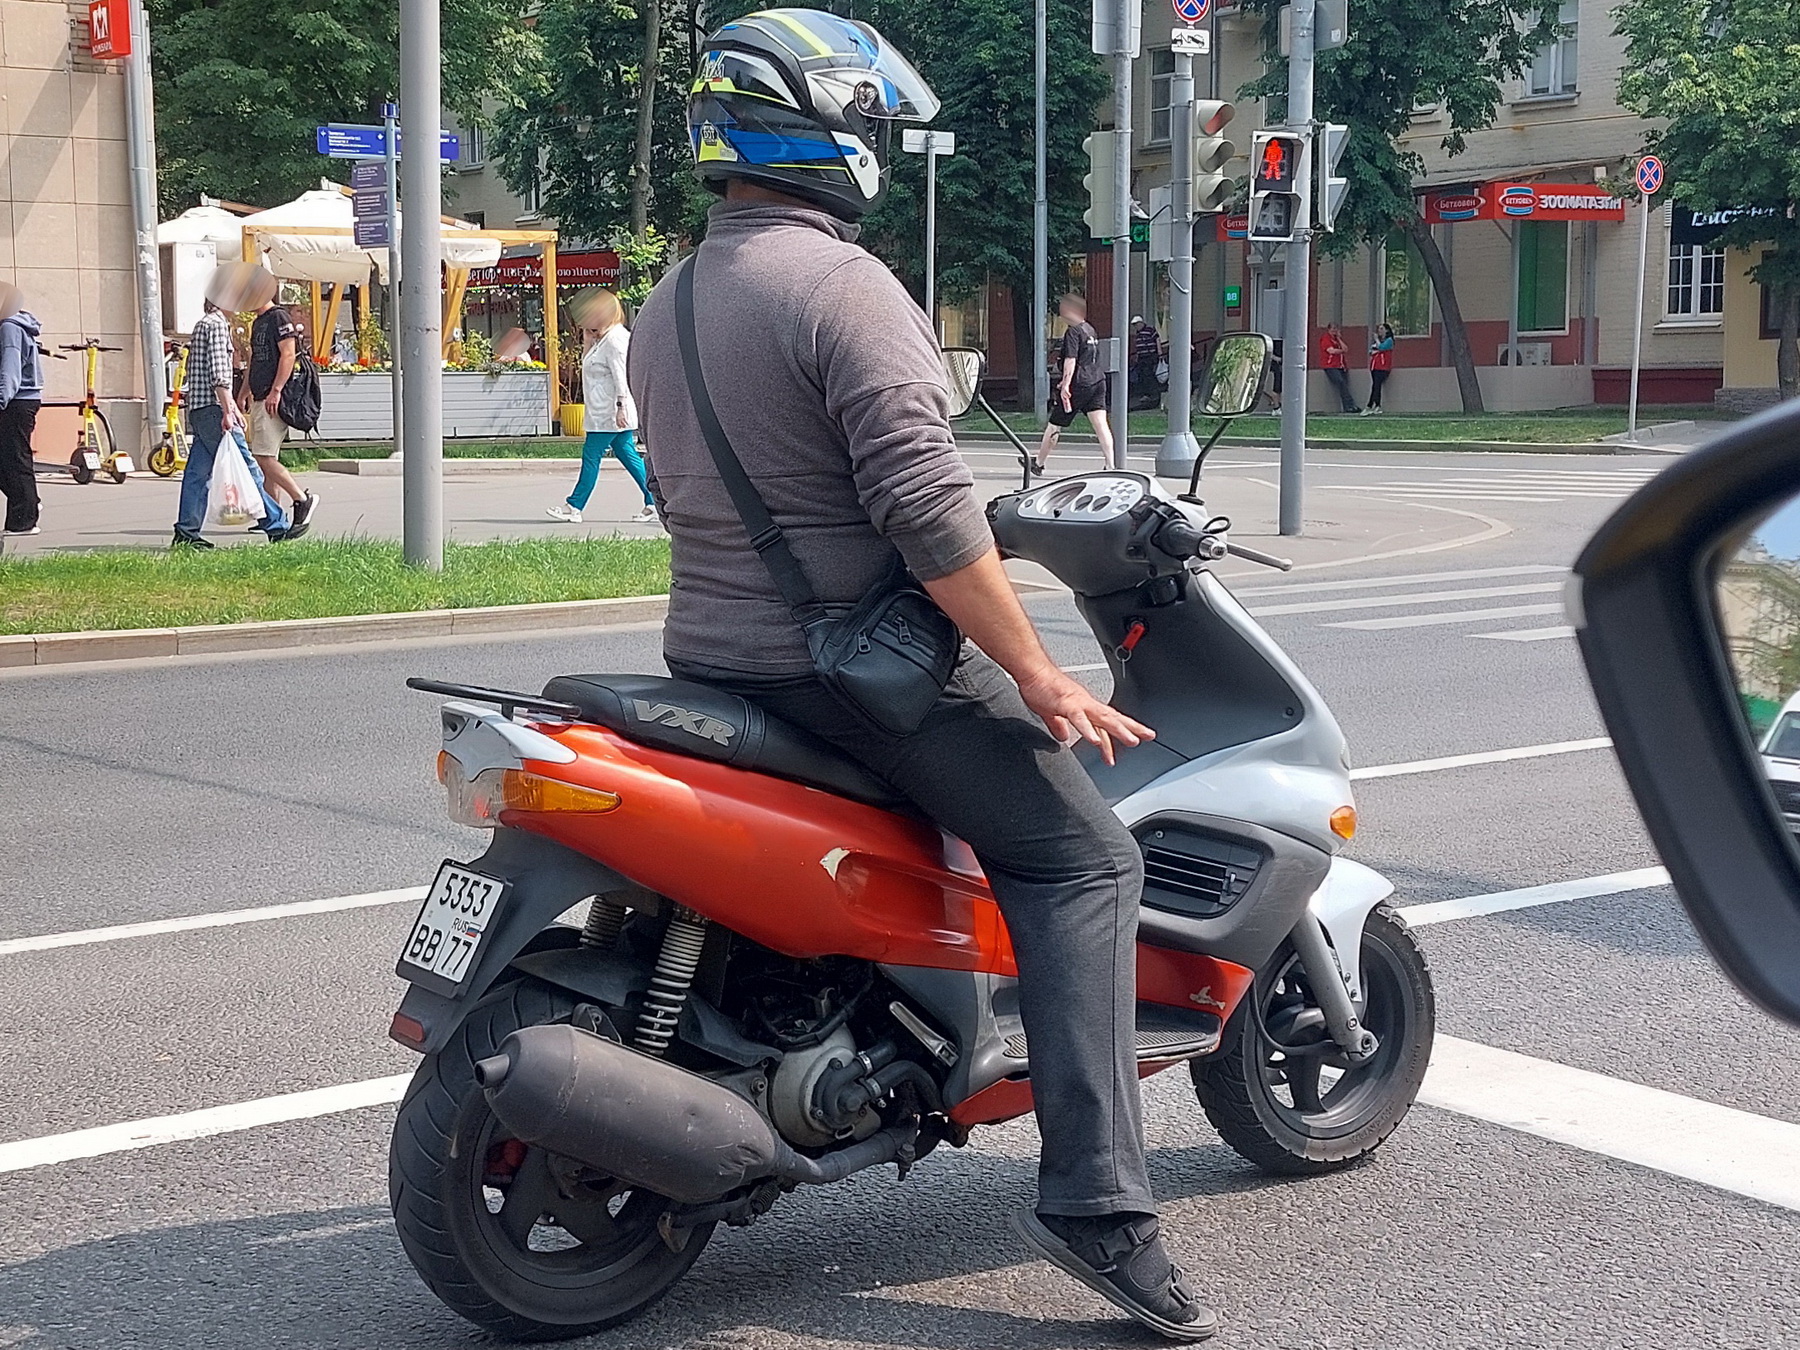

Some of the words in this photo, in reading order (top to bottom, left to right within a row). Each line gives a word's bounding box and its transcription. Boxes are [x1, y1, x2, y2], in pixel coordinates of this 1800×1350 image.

[1538, 194, 1622, 209] ЗООМАГАЗИН
[632, 698, 736, 747] VXR
[439, 872, 493, 917] 5353
[451, 917, 470, 933] RUS
[441, 936, 473, 975] 77
